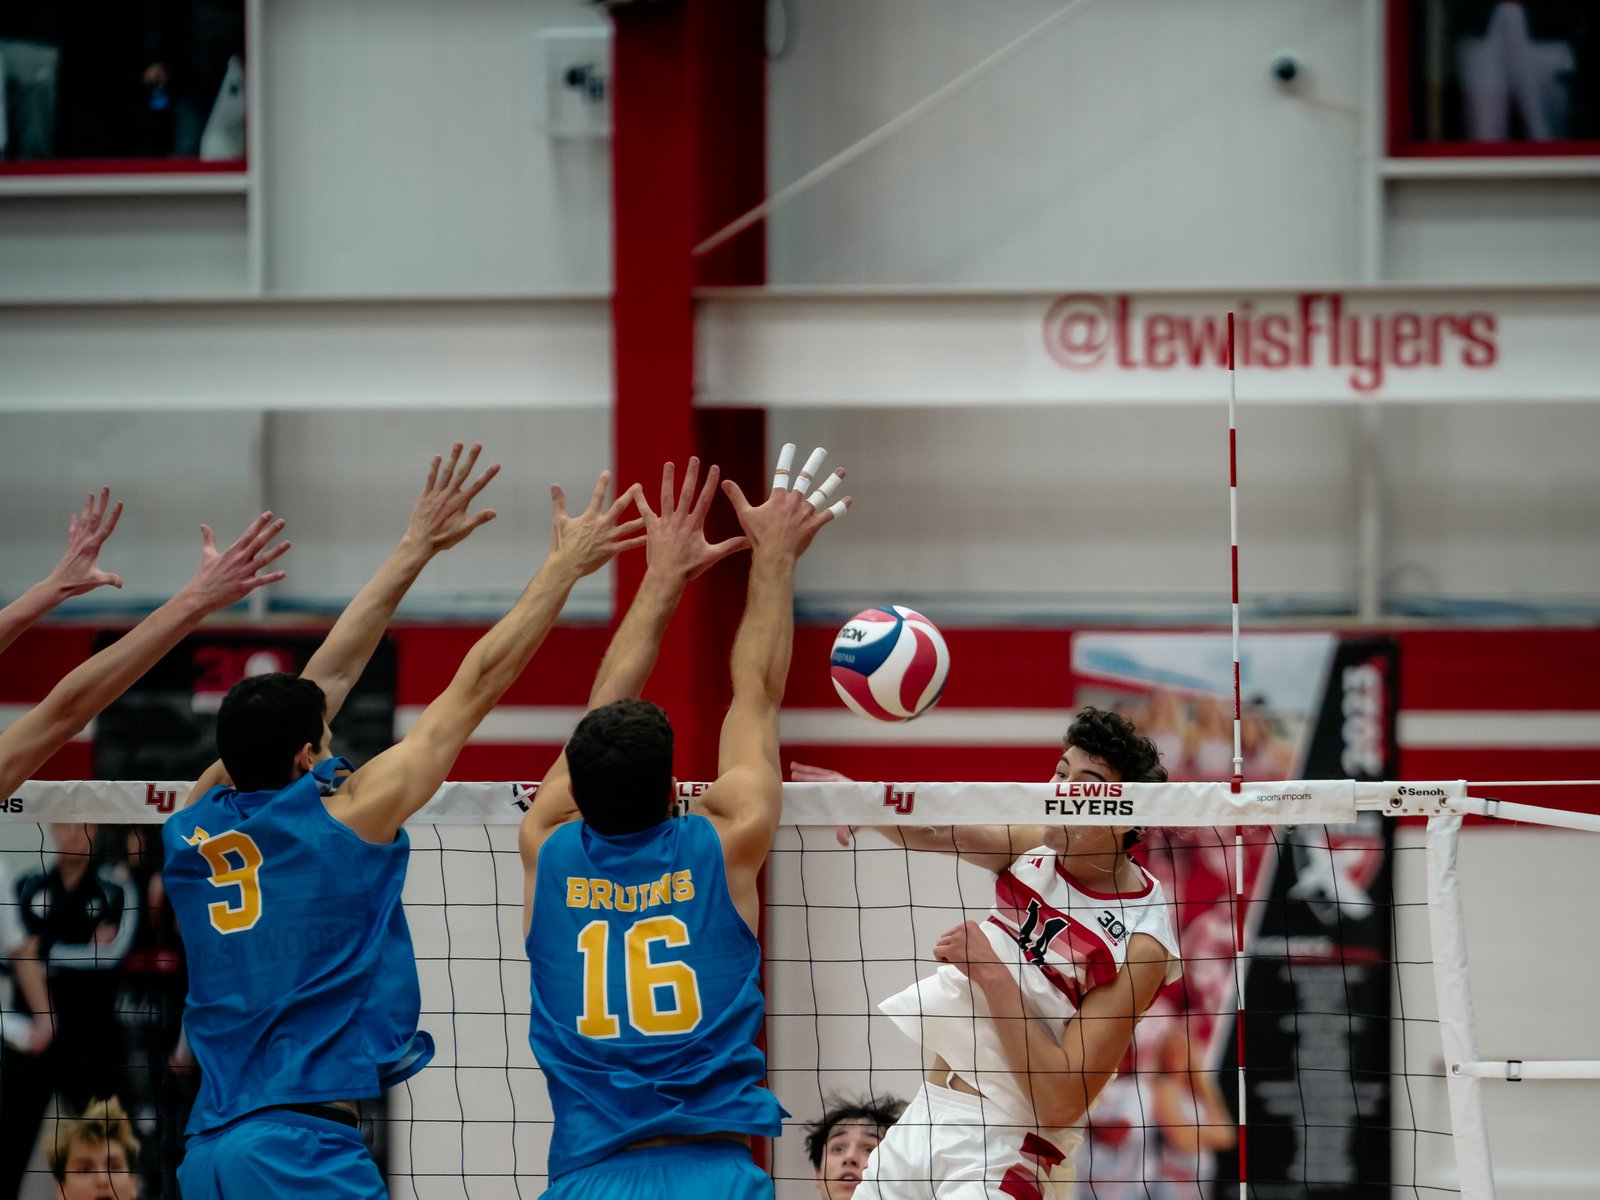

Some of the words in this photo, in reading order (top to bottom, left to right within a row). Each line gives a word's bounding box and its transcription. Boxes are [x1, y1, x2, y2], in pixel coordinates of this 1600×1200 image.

[1043, 292, 1499, 393] @LewisFlyers
[883, 784, 915, 816] LU
[1055, 783, 1123, 797] LEWIS
[1257, 794, 1280, 802] sports
[1282, 793, 1312, 802] imports
[1408, 787, 1445, 796] Senoh
[1045, 799, 1134, 816] FLYERS
[198, 830, 263, 935] 9
[566, 869, 695, 912] BRUINS
[576, 915, 702, 1039] 16
